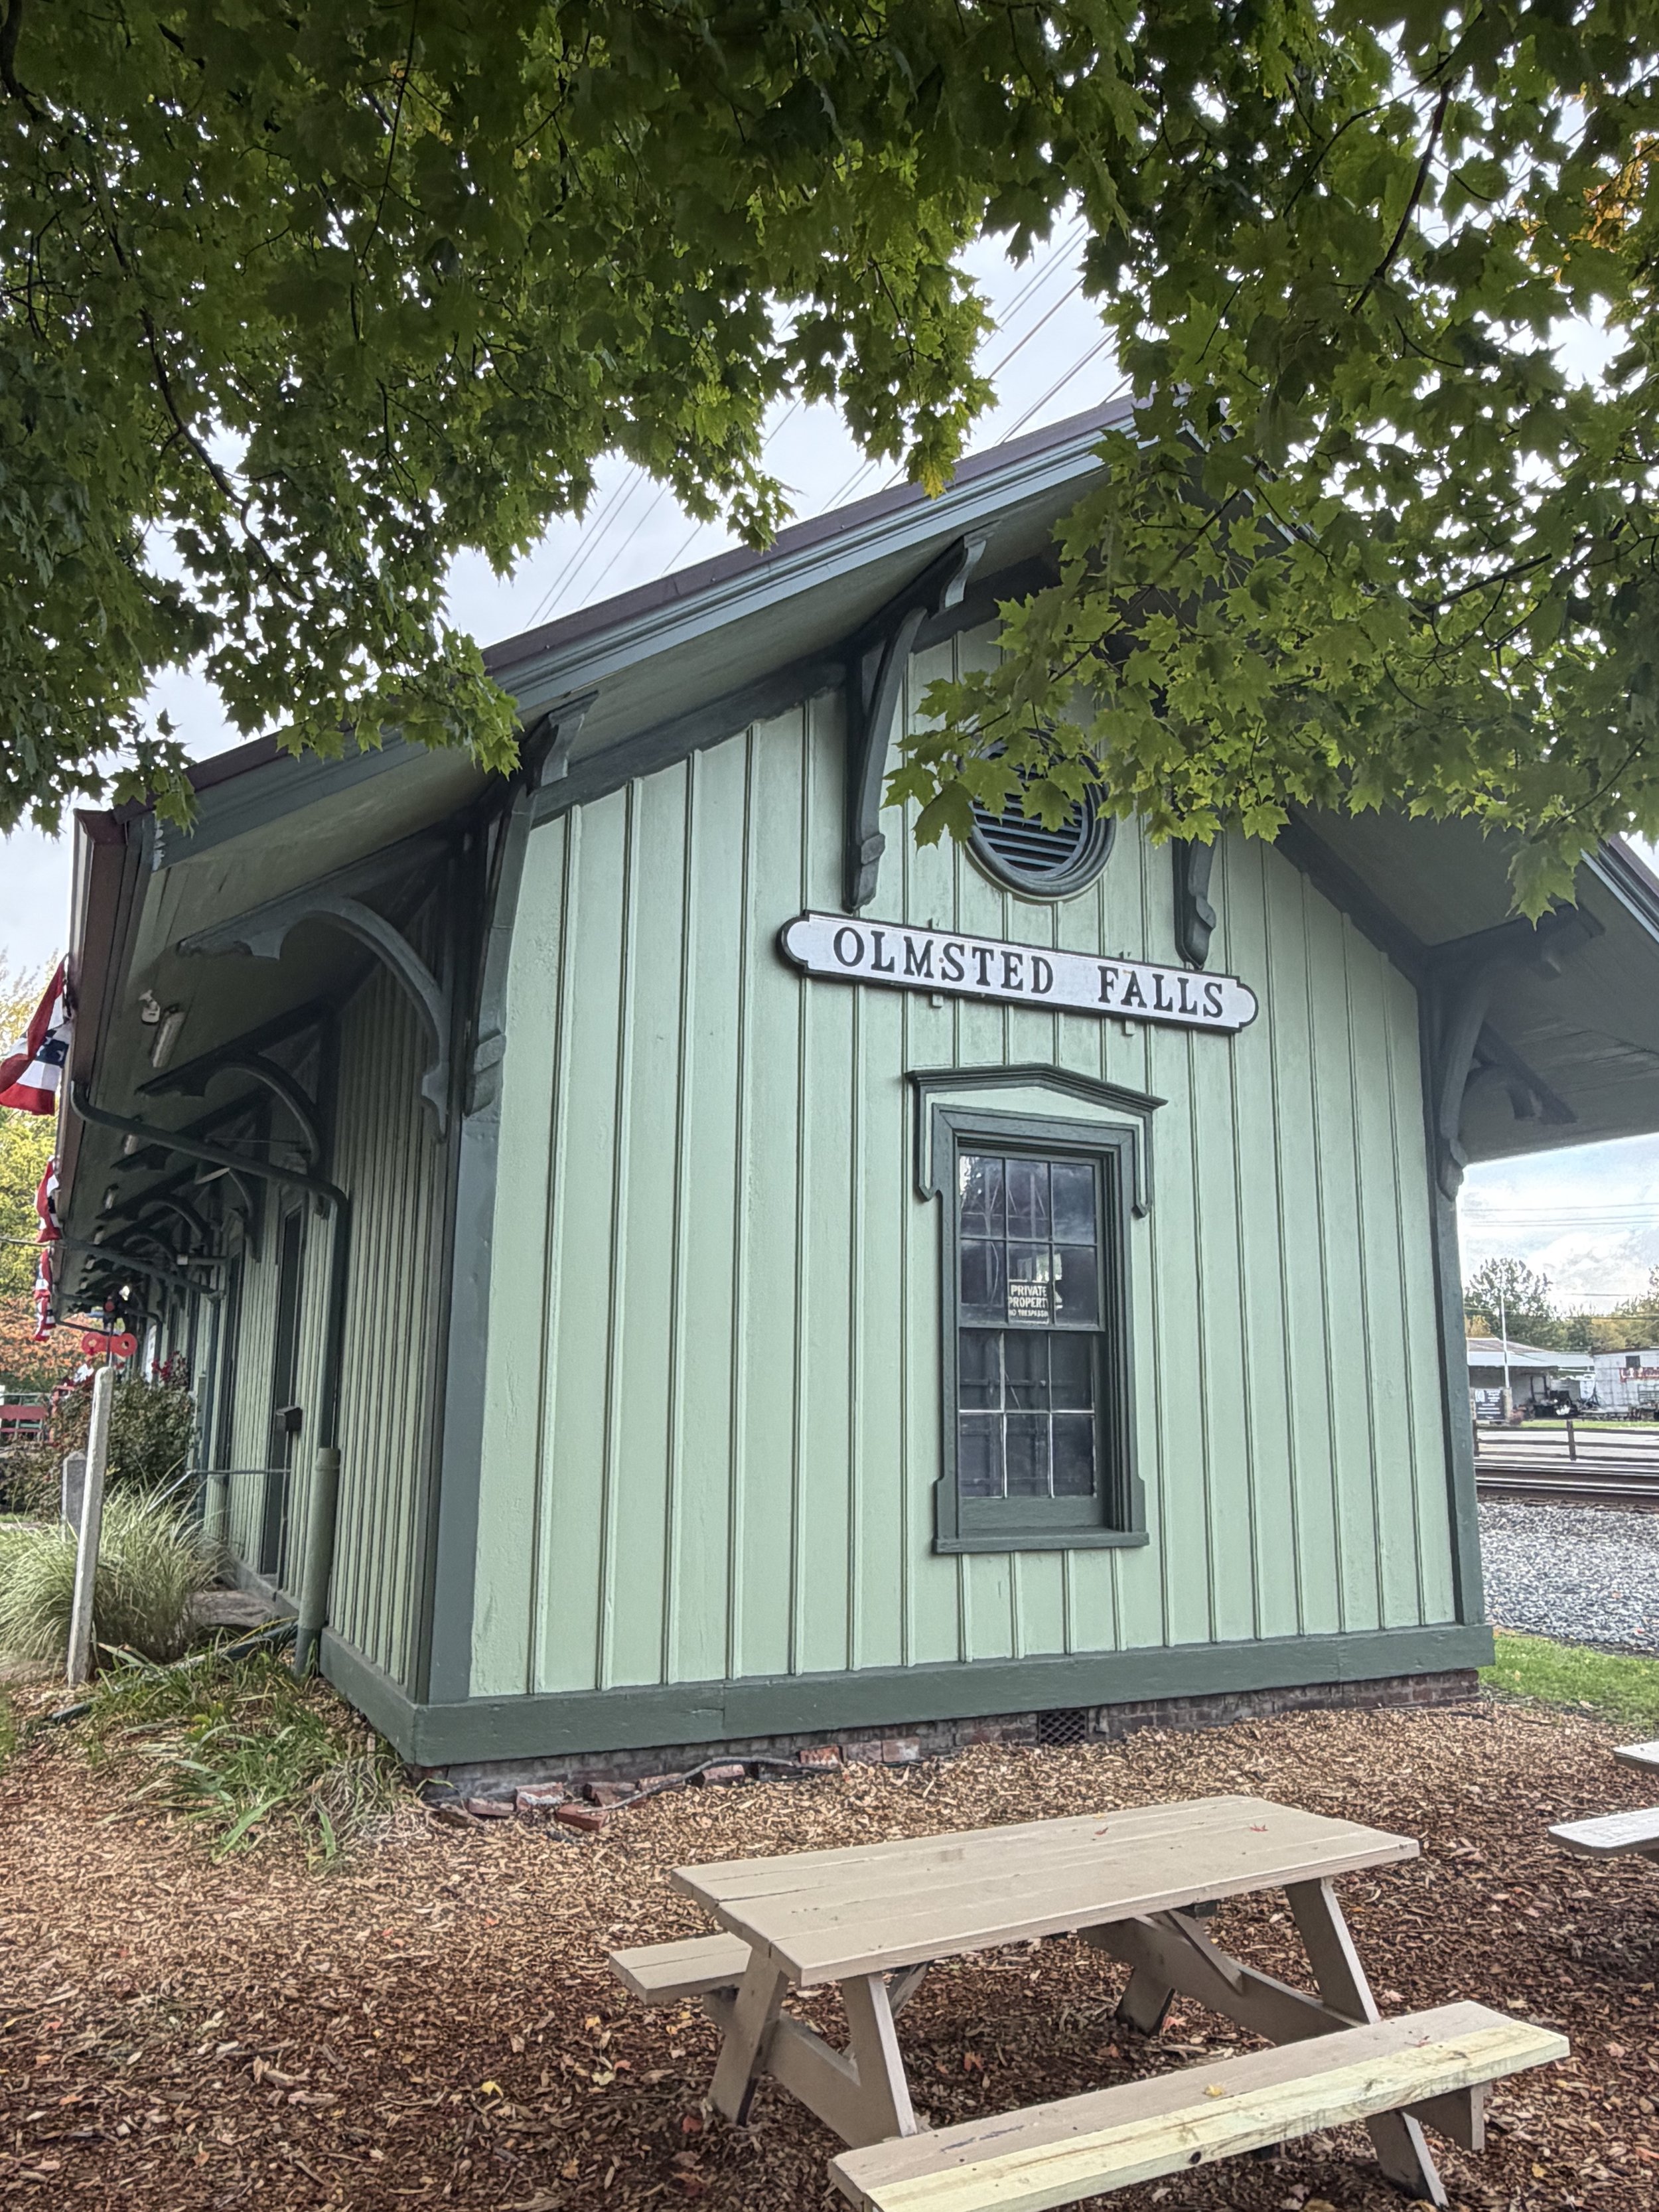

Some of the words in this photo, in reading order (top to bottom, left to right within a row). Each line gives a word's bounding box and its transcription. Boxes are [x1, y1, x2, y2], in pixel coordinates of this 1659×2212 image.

[833, 926, 1053, 994] OLMSTED
[1098, 965, 1223, 1018] FALLS
[1011, 1285, 1046, 1297] PRIVATE
